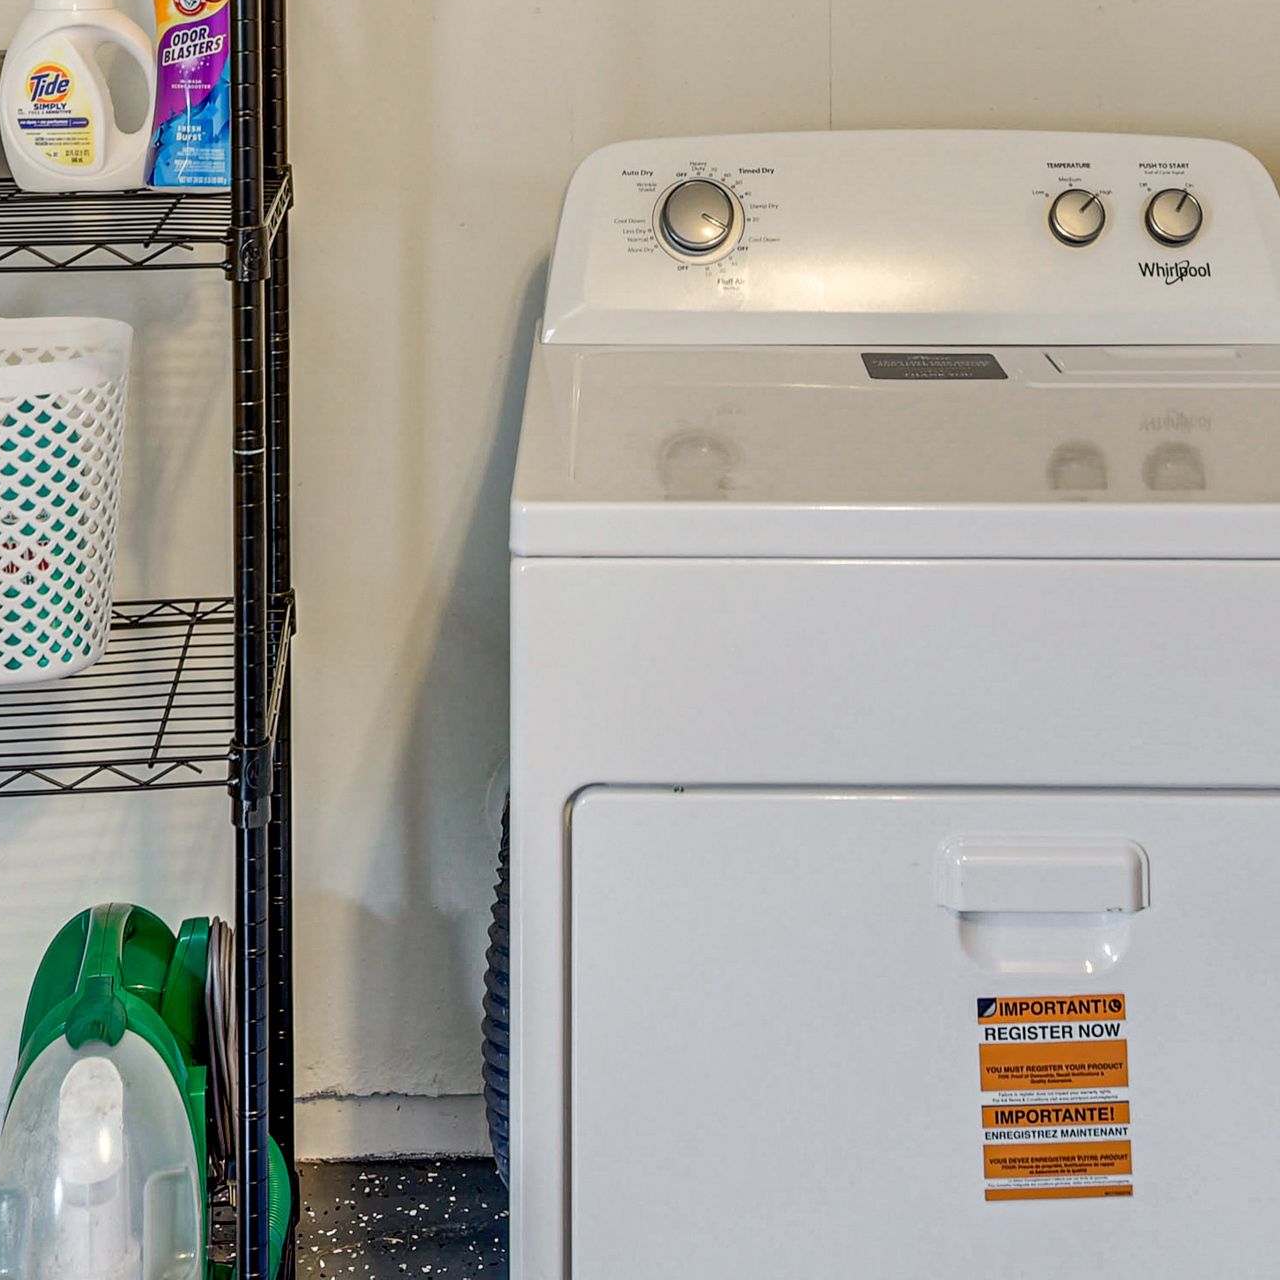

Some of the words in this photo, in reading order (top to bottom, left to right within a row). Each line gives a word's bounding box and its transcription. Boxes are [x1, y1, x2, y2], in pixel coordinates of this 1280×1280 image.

[173, 27, 208, 46] ODOR
[164, 37, 223, 63] BLASTERS
[30, 73, 70, 102] Tide
[176, 132, 201, 140] Burst
[1138, 260, 1211, 285] Whirlpool
[999, 999, 1107, 1016] IMPORTANT!
[984, 1025, 1073, 1041] REGISTER
[1079, 1023, 1121, 1039] NOW
[1026, 1064, 1063, 1072] REGISTER
[1065, 1063, 1086, 1071] YOUR
[1087, 1062, 1123, 1070] PRODUCT
[995, 1107, 1115, 1124] IMPORTANTE!
[984, 1129, 1058, 1141] ENREGISTREZ
[1060, 1127, 1129, 1138] MAINTENANT
